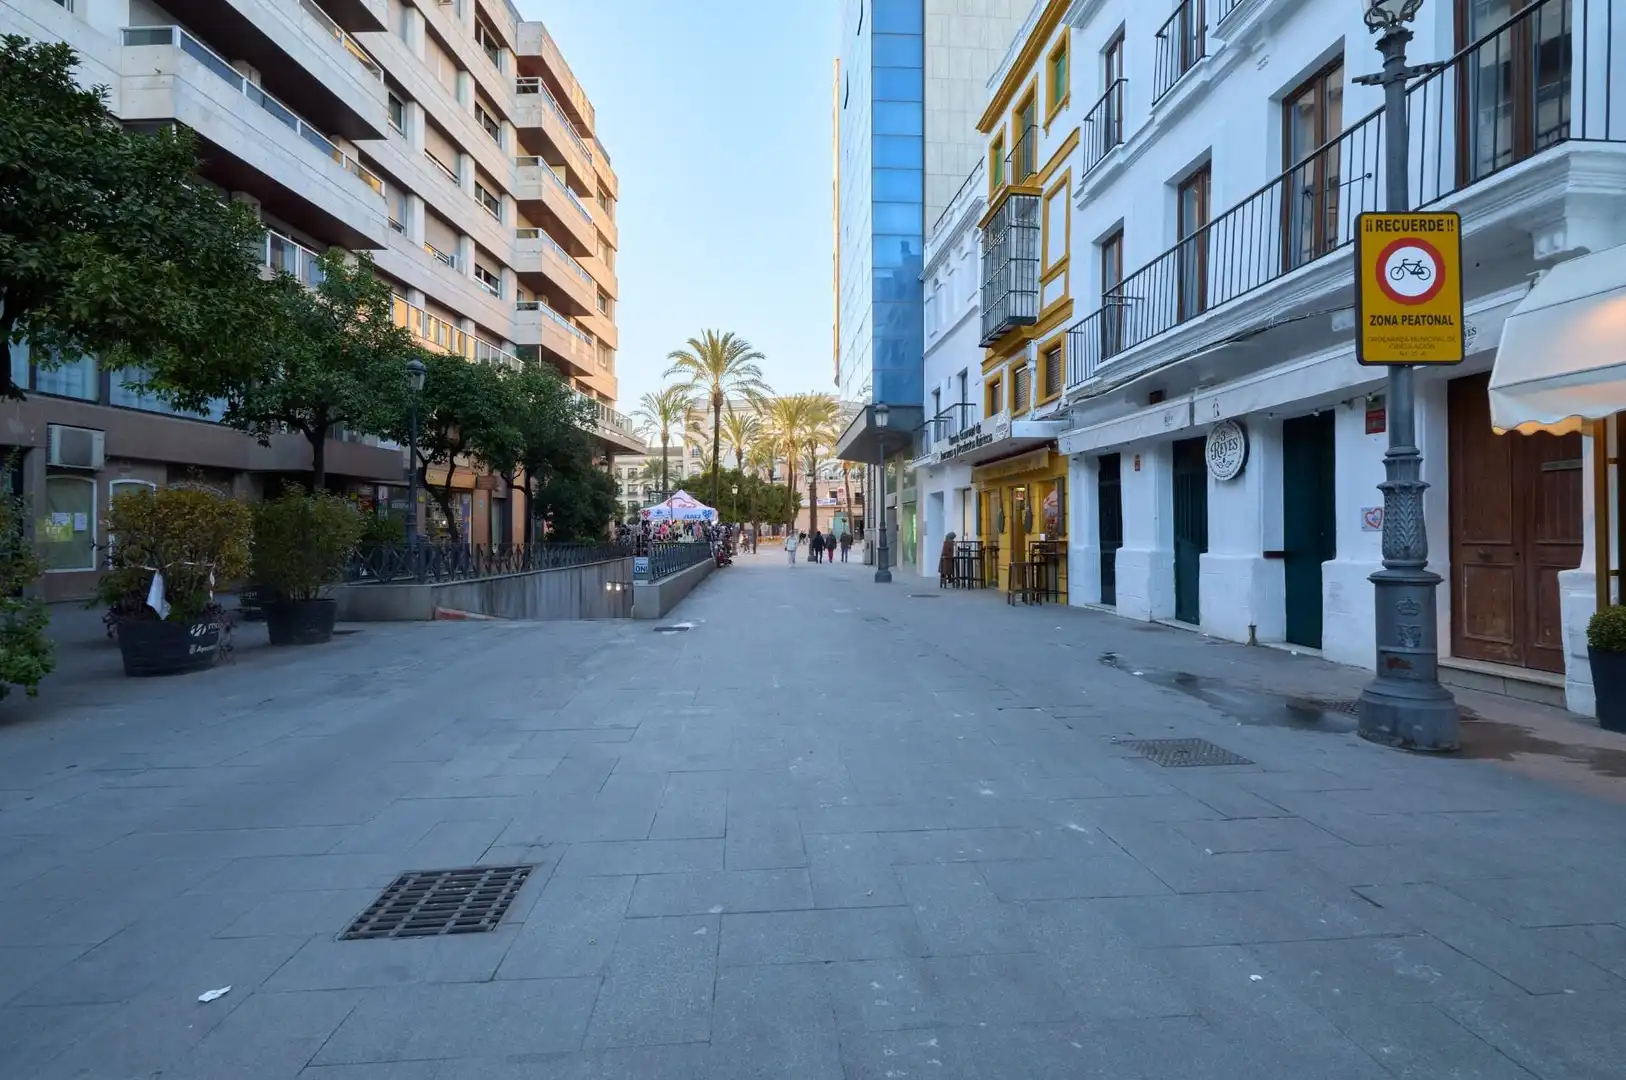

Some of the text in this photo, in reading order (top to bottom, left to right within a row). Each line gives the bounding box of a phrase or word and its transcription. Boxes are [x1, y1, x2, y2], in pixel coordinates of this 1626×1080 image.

[1370, 315, 1454, 326] ZONA PEATONAL
[1220, 430, 1226, 441] 3
[1210, 437, 1238, 460] REYES
